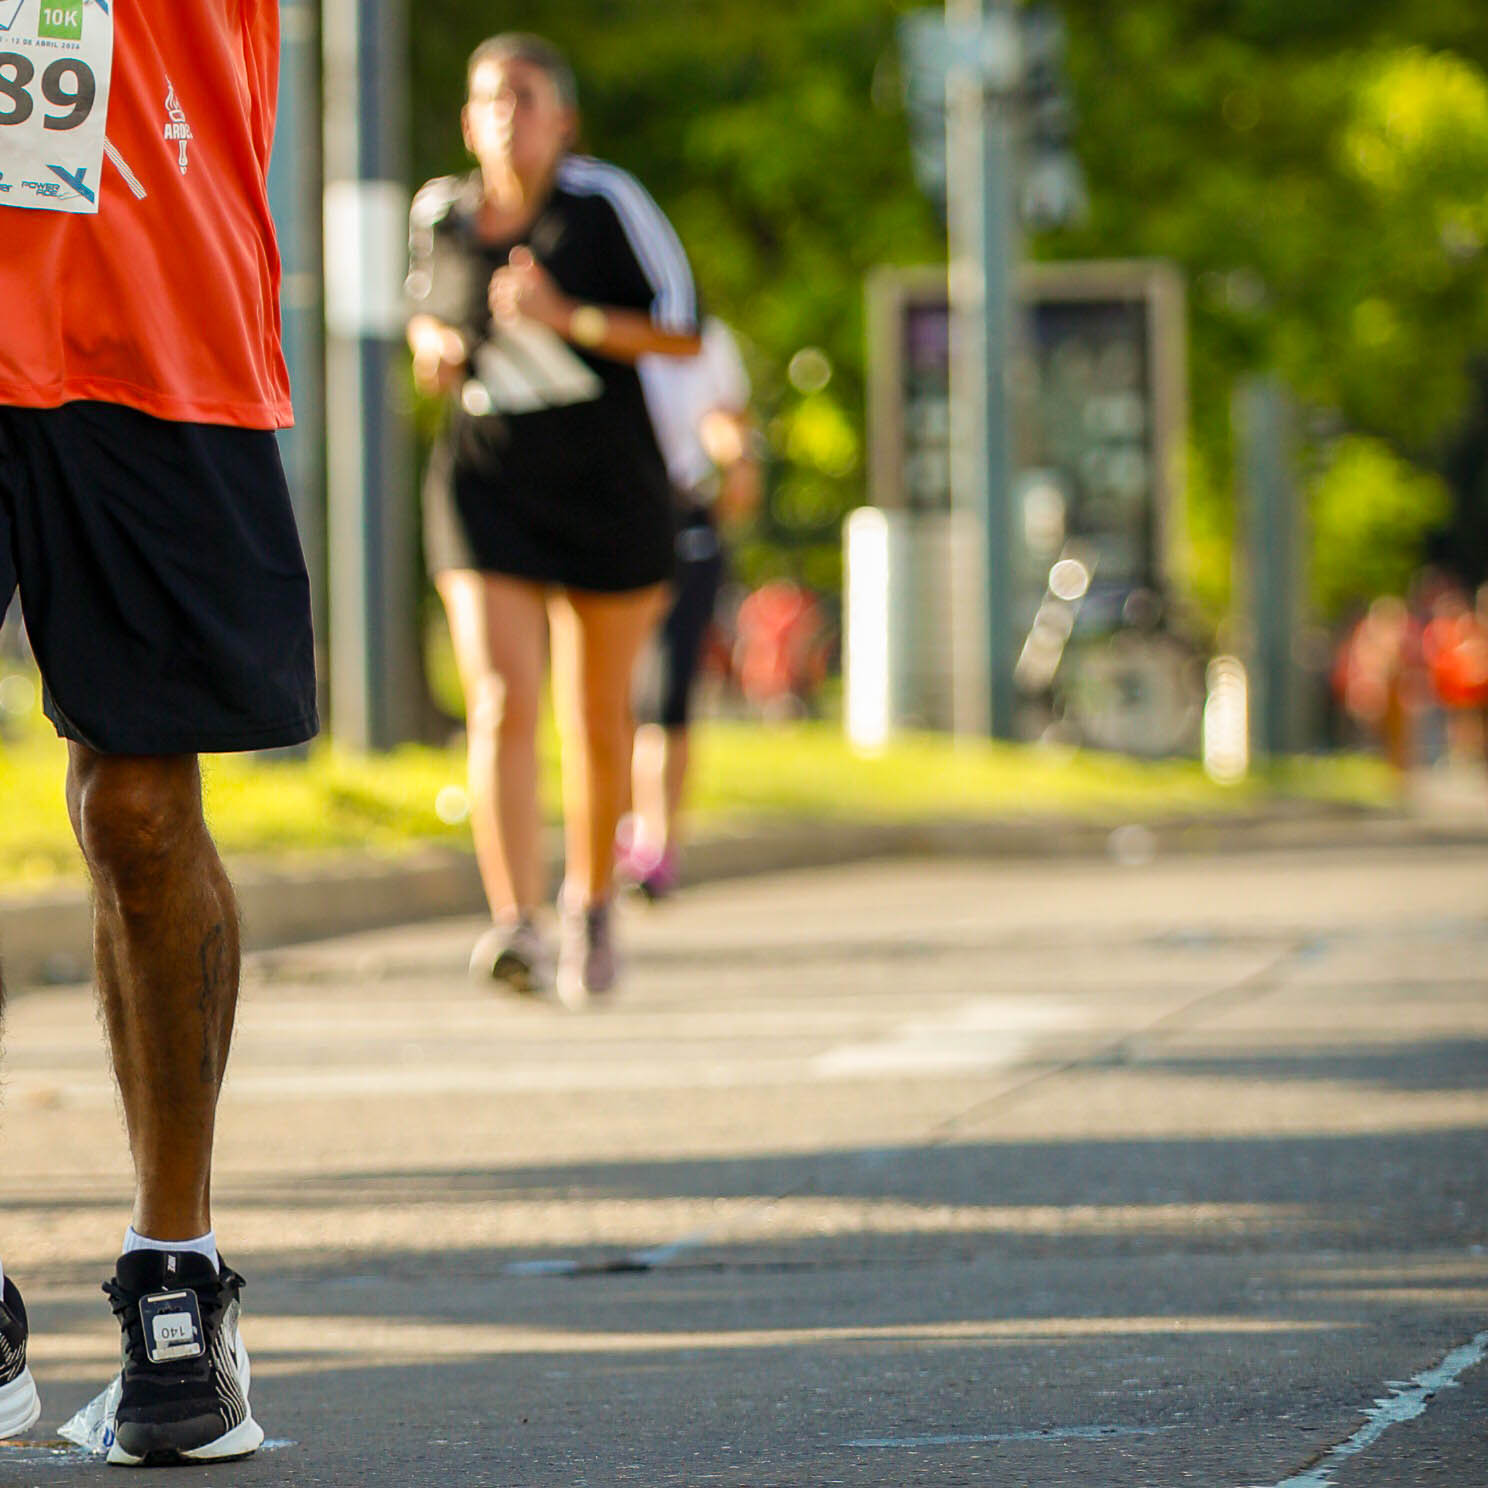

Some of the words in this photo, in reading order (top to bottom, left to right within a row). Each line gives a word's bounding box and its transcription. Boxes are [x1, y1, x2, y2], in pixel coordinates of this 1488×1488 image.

[43, 8, 78, 27] 10K
[23, 38, 32, 46] DE
[35, 40, 57, 48] ABRIL
[161, 1326, 185, 1339] 140
